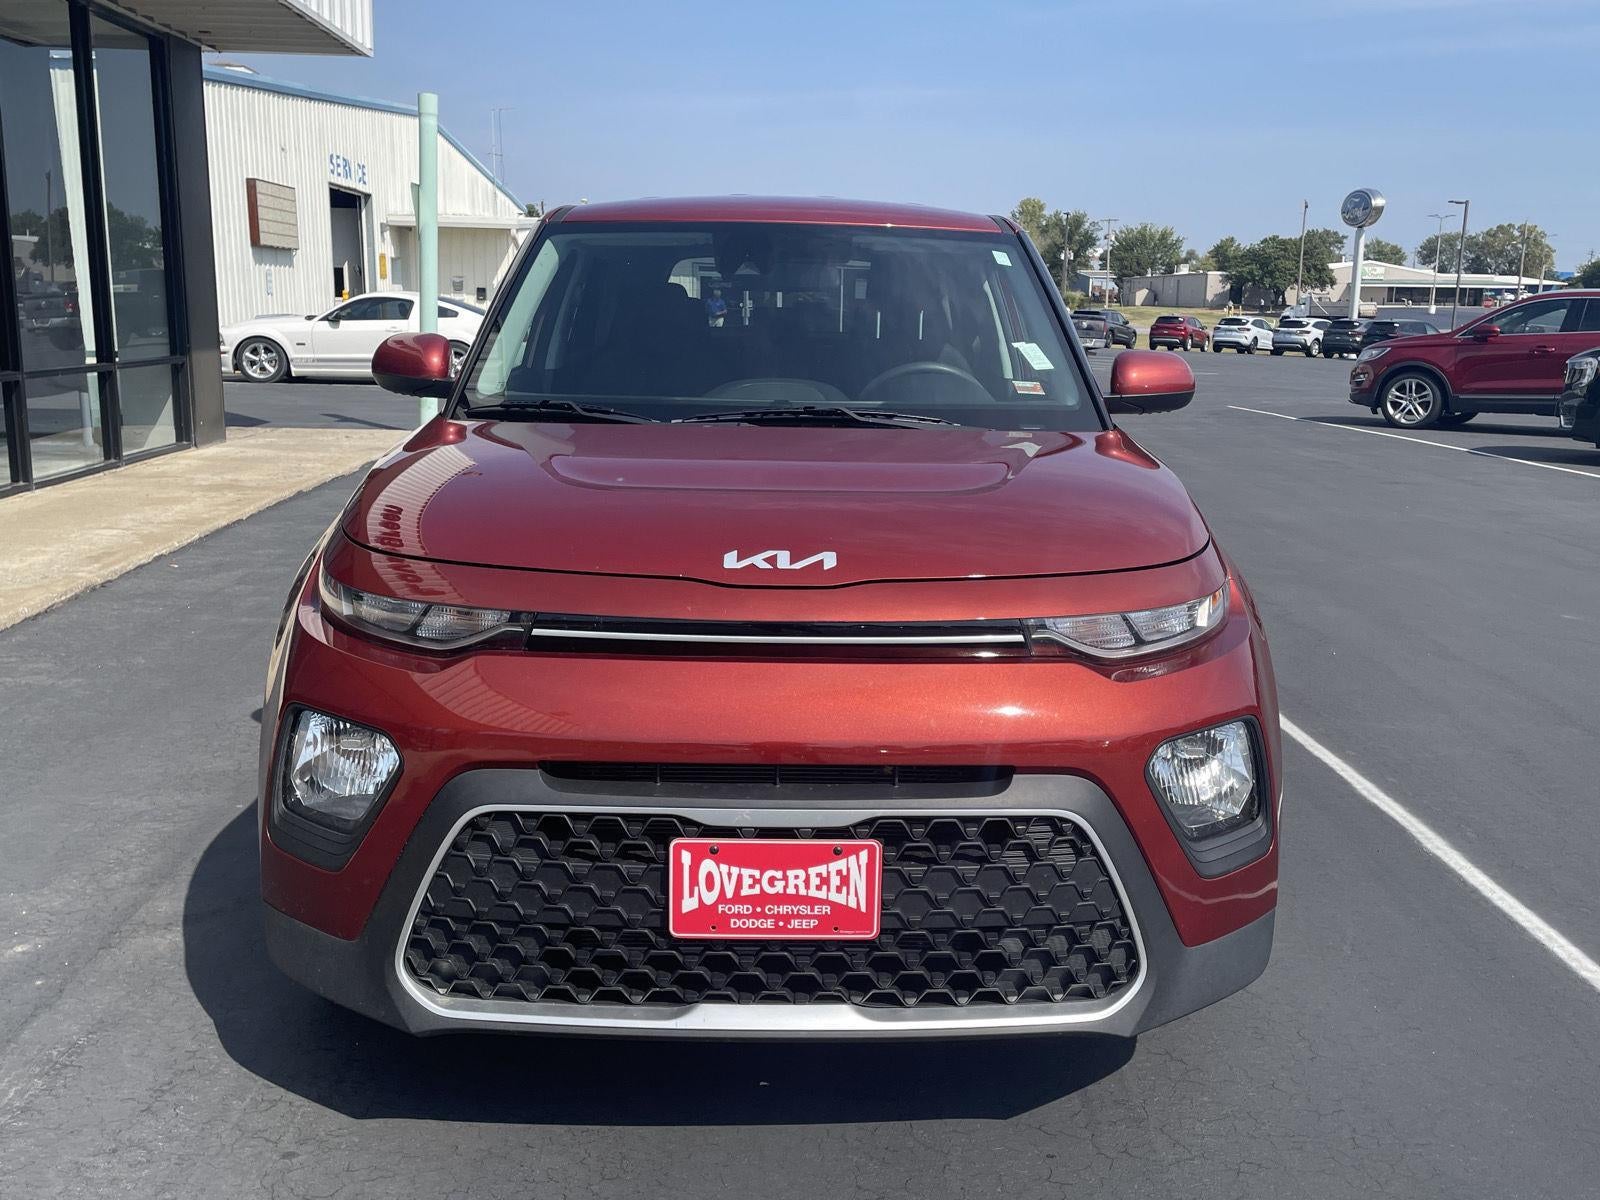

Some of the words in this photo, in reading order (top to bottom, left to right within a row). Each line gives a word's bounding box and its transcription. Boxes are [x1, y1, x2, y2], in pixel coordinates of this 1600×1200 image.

[681, 848, 869, 914] LOVEGREEN
[718, 904, 752, 915] FORD
[765, 905, 831, 915] CHRYSLER
[730, 918, 775, 929] DODGE
[787, 919, 818, 929] JEEP
